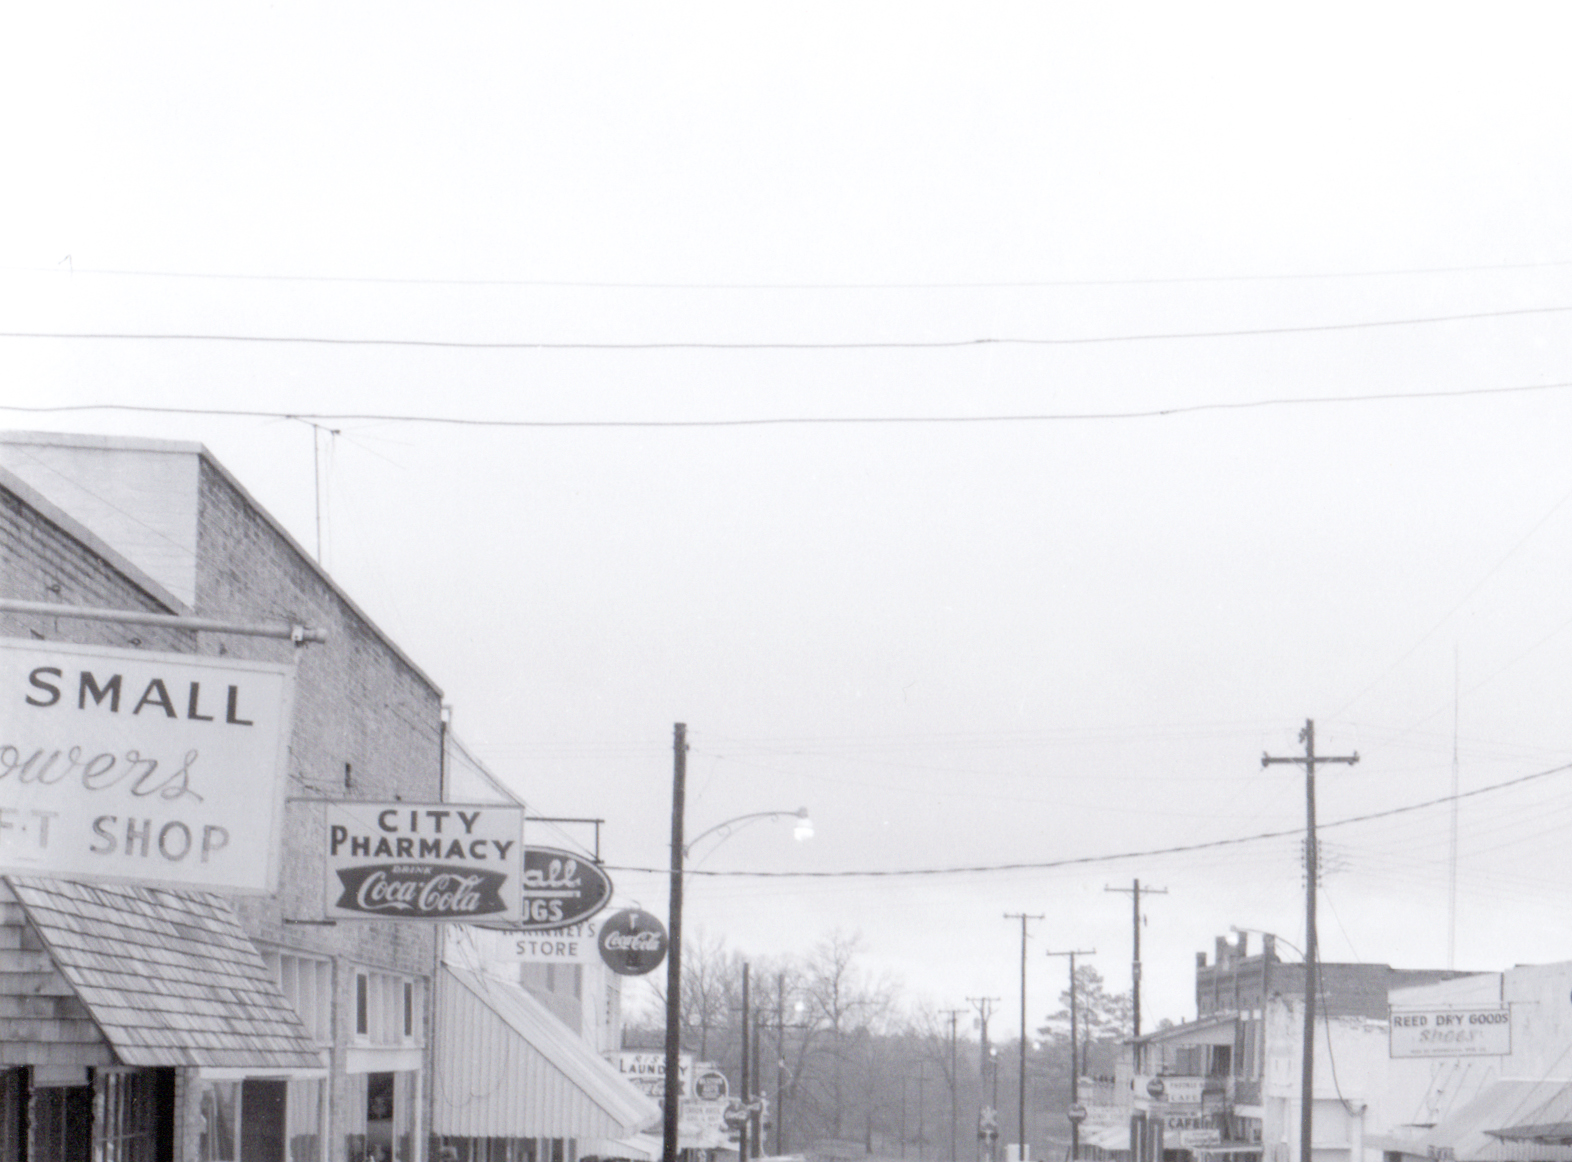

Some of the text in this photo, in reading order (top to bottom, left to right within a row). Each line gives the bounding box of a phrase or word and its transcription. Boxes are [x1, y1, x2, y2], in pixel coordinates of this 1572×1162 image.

[25, 666, 254, 727] SMALL
[378, 809, 481, 835] CITY
[90, 814, 230, 864] SHOP
[330, 825, 515, 861] PHARMACY
[391, 865, 433, 875] DRINK
[356, 870, 484, 912] Coca-Cola
[516, 940, 579, 956] STORE
[1393, 1013, 1509, 1027] REED DRY GOODS
[619, 1058, 687, 1076] LAUNDY
